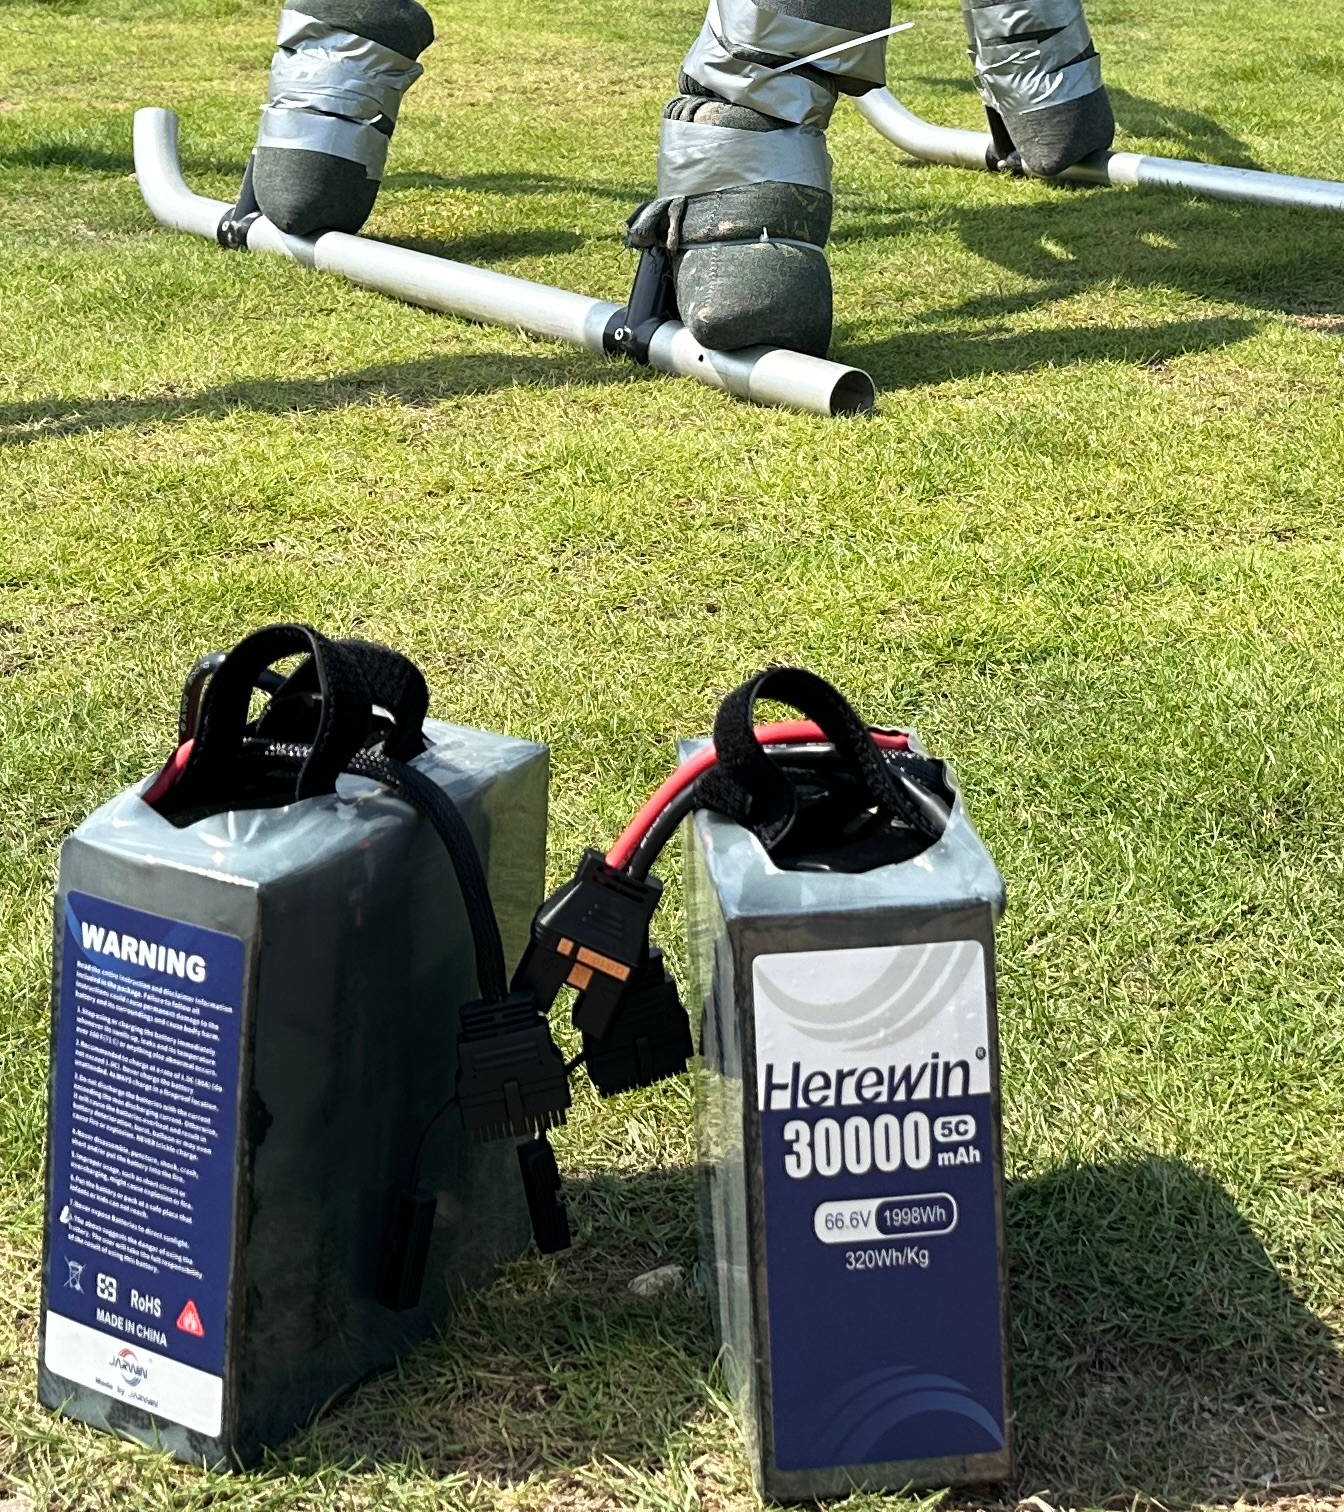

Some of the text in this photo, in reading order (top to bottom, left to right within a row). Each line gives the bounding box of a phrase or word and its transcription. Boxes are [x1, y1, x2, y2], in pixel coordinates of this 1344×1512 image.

[81, 921, 206, 983] WARNING
[784, 1111, 969, 1178] 30000 5C
[938, 1146, 980, 1166] mAh
[825, 1205, 946, 1230] 66.6V 1998Wh
[846, 1246, 929, 1270] 320Wh/Kg
[131, 1288, 161, 1318] RoHS
[97, 1308, 167, 1347] MADE IN CHINA
